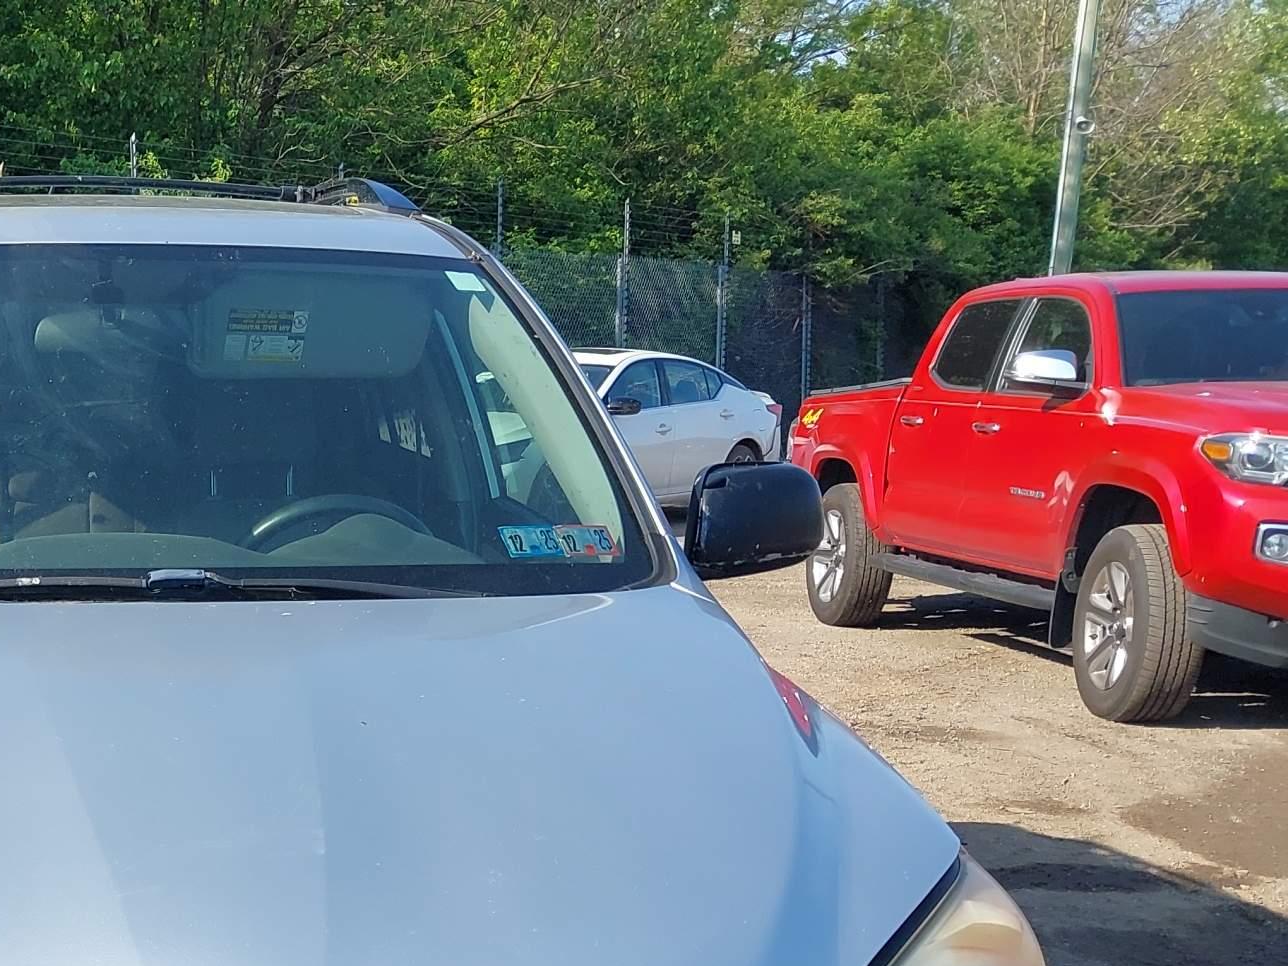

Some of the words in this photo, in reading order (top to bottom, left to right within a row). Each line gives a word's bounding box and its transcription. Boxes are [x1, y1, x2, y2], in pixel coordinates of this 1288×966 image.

[508, 534, 528, 552] 12
[540, 529, 560, 551] 25
[562, 534, 581, 552] 12
[594, 529, 613, 551] 25
